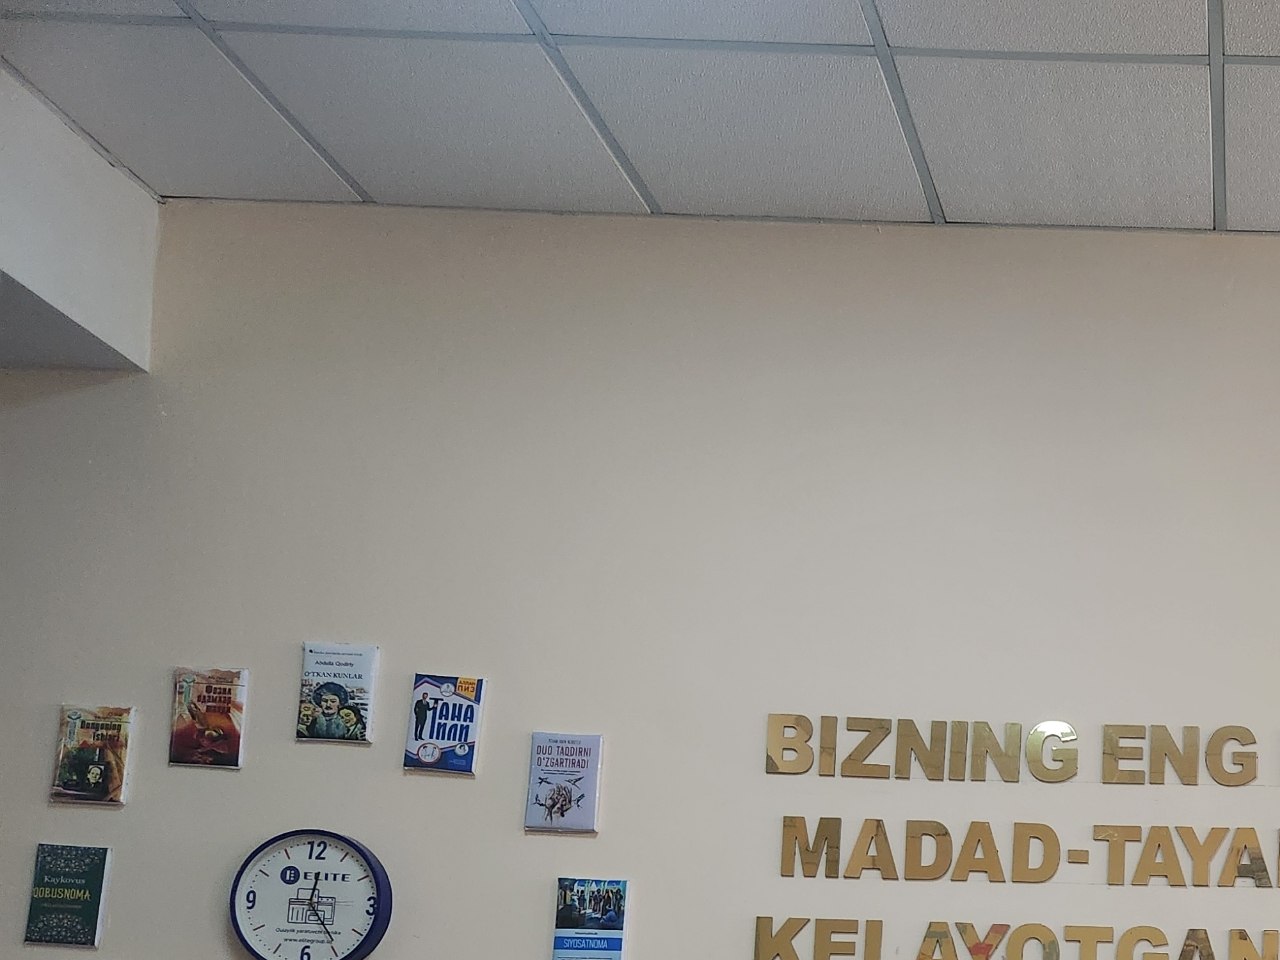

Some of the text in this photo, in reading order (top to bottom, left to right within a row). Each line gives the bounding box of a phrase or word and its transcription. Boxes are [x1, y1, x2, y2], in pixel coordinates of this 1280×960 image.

[536, 745, 591, 757] DUO TAQDIRNI
[766, 713, 1078, 783] BIZNING
[1102, 724, 1258, 787] ENG
[307, 841, 327, 860] 12
[246, 890, 256, 910] 9
[365, 896, 377, 916] 3
